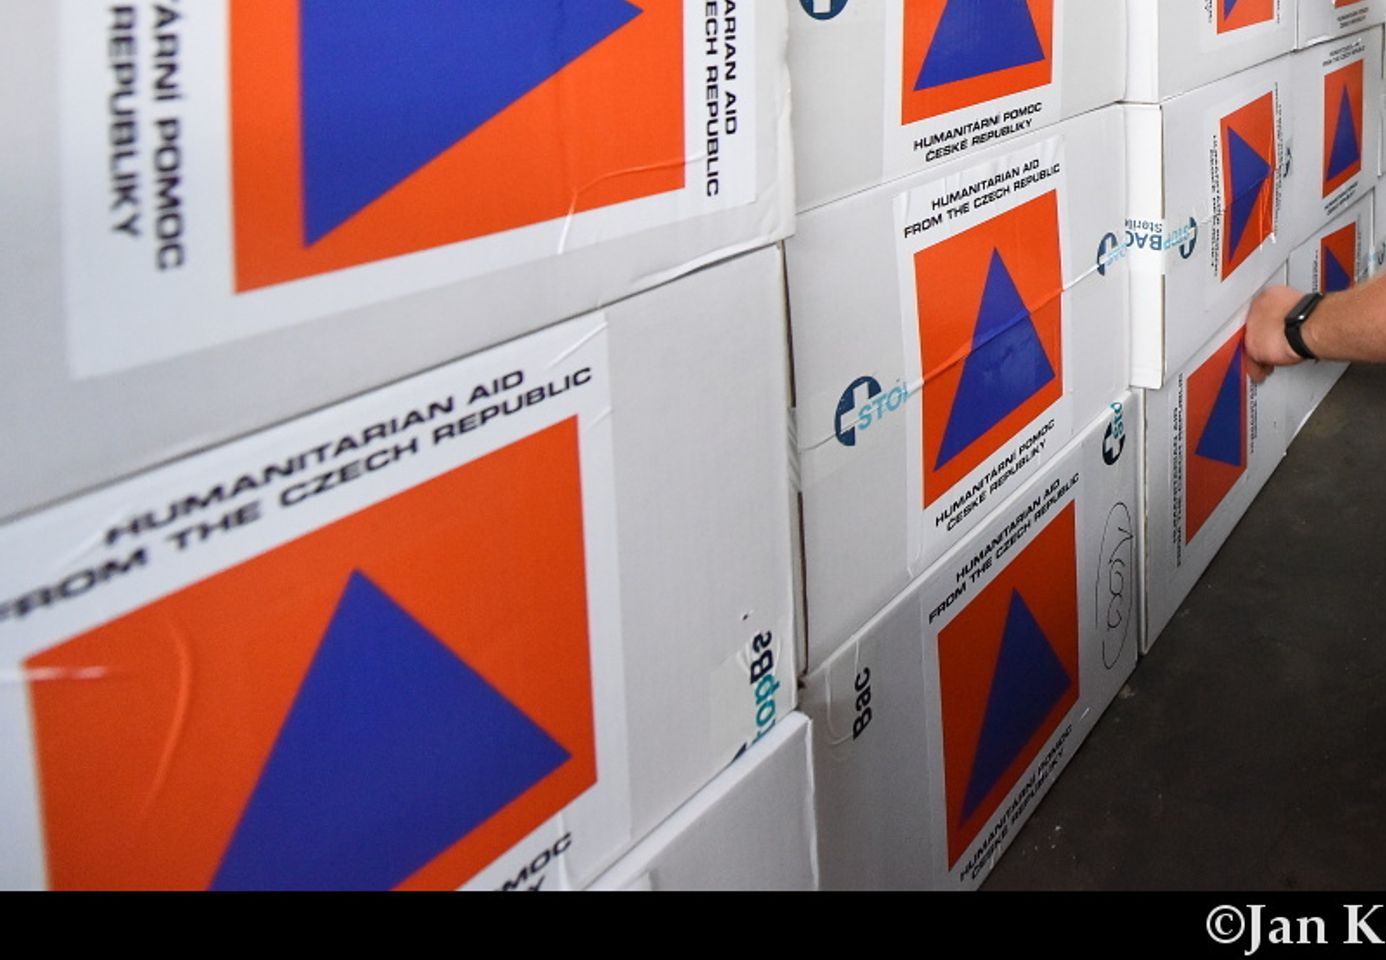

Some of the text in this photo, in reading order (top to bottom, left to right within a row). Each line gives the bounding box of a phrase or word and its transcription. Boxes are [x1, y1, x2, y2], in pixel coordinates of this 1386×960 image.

[108, 4, 142, 240] REPUBLIKY
[704, 64, 719, 198] REPUBLIC
[724, 89, 737, 136] AID
[971, 118, 1032, 146] REPUBLIKY
[1003, 102, 1043, 122] POMOC
[152, 116, 186, 272] POMOC
[904, 163, 1060, 239] FROM THE CZECH REPUBLIC
[931, 159, 1040, 211] HUMANITARIAN AID
[103, 369, 526, 544] HUMANITARIAN AID
[169, 500, 264, 551] THE
[279, 436, 421, 508] CZECH
[431, 366, 594, 446] REPUBLIC
[989, 439, 1046, 494] REPUBLIKY
[1018, 418, 1055, 455] POMOC
[928, 472, 1080, 625] FROM THE CZECH REPUBLIC
[956, 478, 1061, 583] HUMANITARIAN AID
[853, 667, 872, 740] Bac
